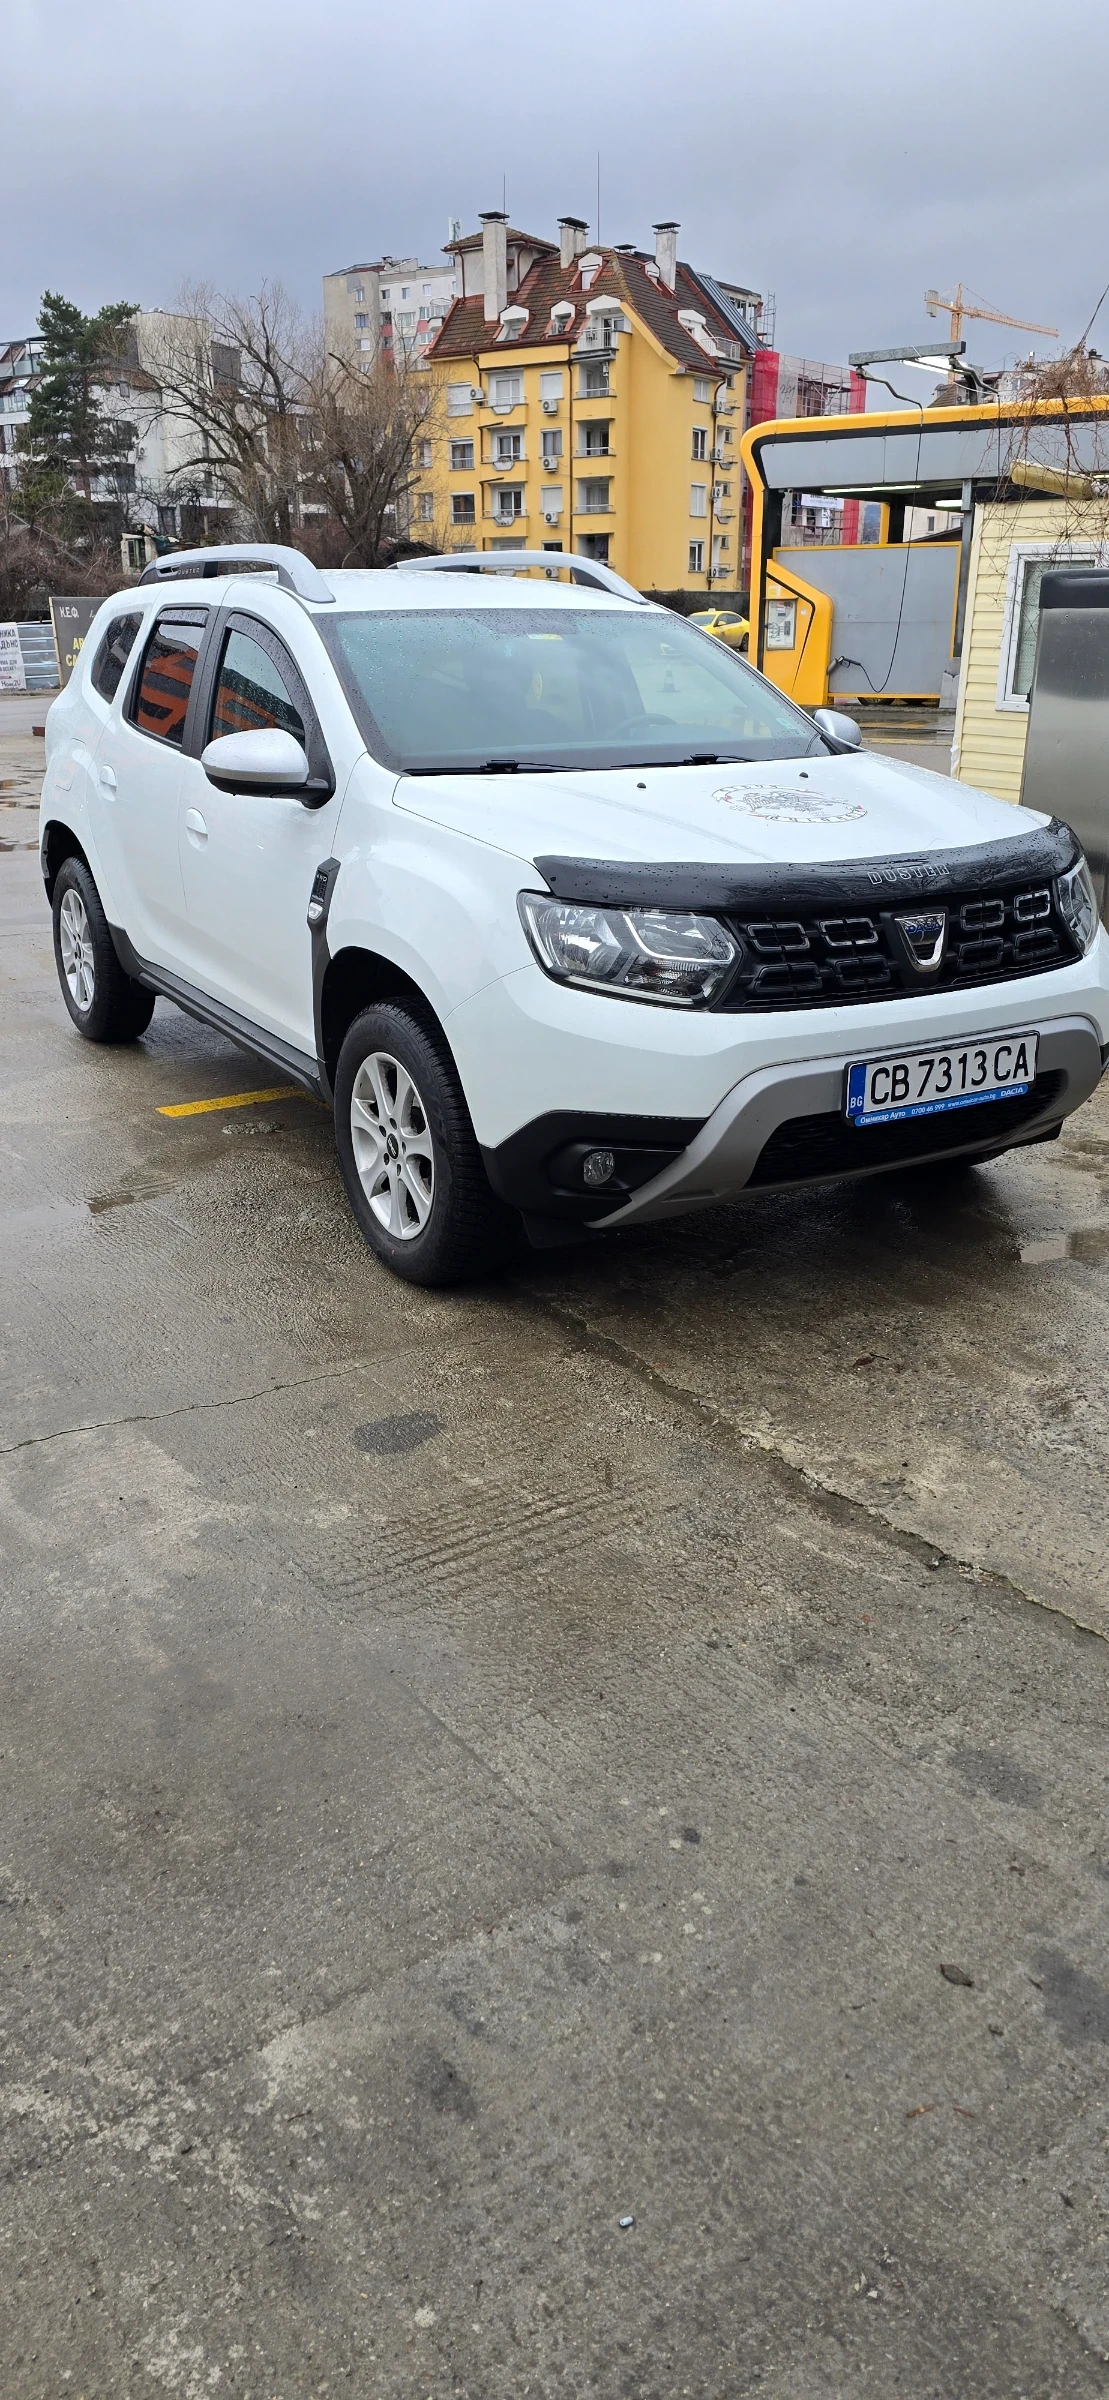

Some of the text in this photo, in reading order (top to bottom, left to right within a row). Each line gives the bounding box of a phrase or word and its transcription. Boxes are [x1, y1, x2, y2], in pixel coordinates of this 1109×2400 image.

[867, 864, 950, 884] DUSTER
[870, 1042, 1029, 1105] CB 7313 CA
[850, 1094, 863, 1109] BG
[890, 1111, 906, 1120] Ауто
[911, 1106, 925, 1115] 0700
[934, 1103, 945, 1111] 999
[1001, 1087, 1023, 1097] DACIA
